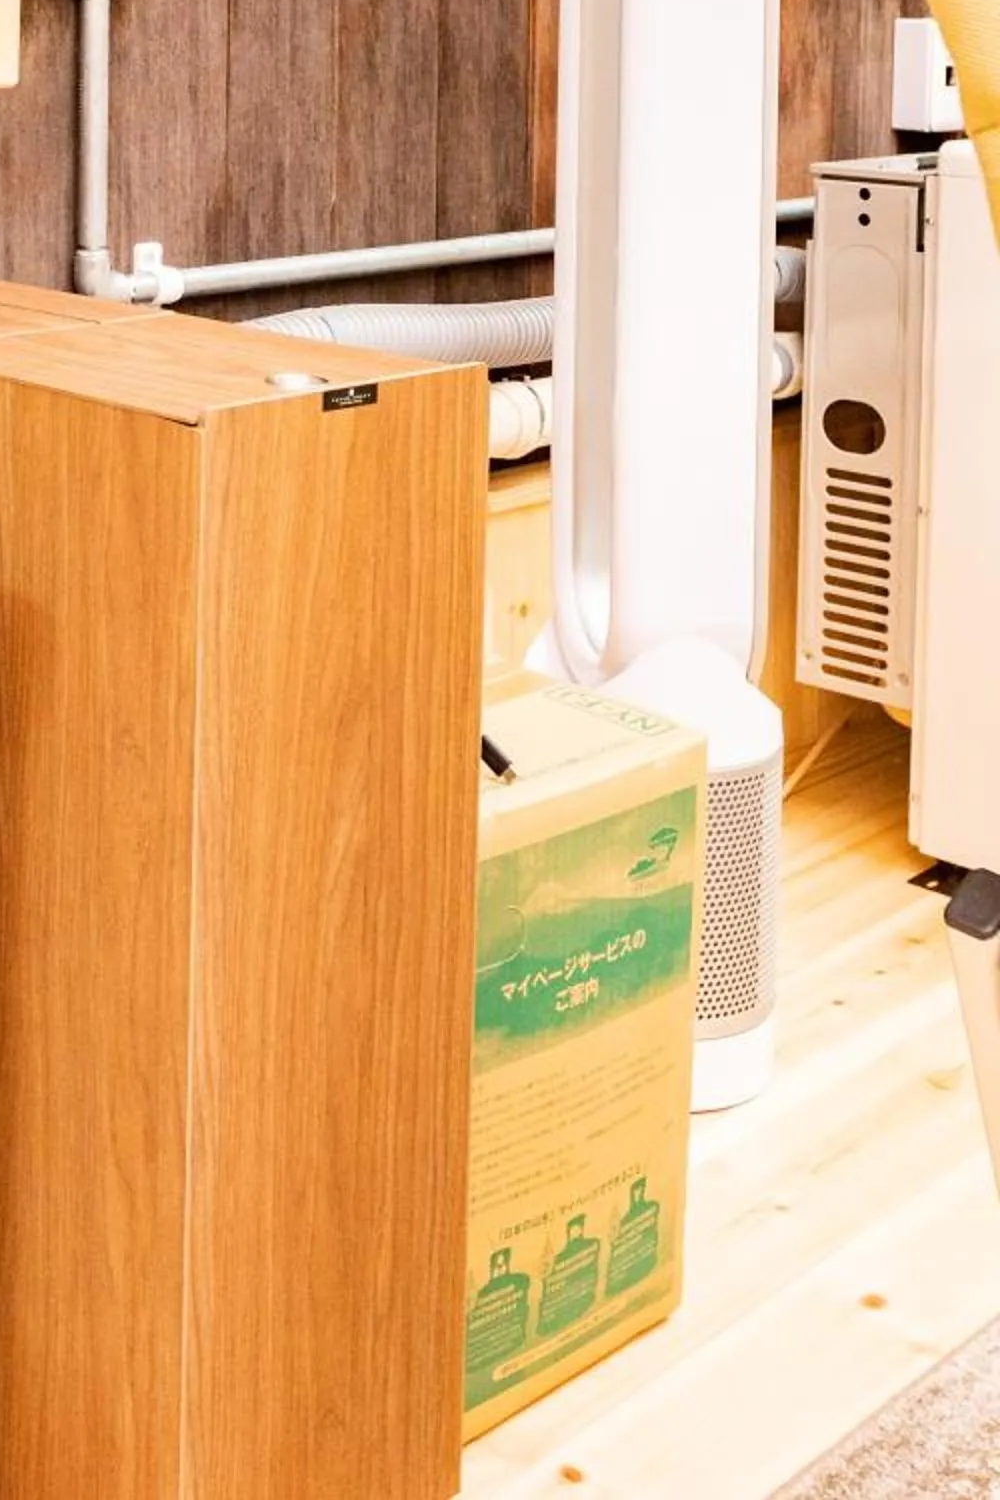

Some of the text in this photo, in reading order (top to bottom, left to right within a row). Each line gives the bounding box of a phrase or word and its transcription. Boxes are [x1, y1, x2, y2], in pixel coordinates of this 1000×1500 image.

[501, 928, 647, 1000] マイページサービスの
